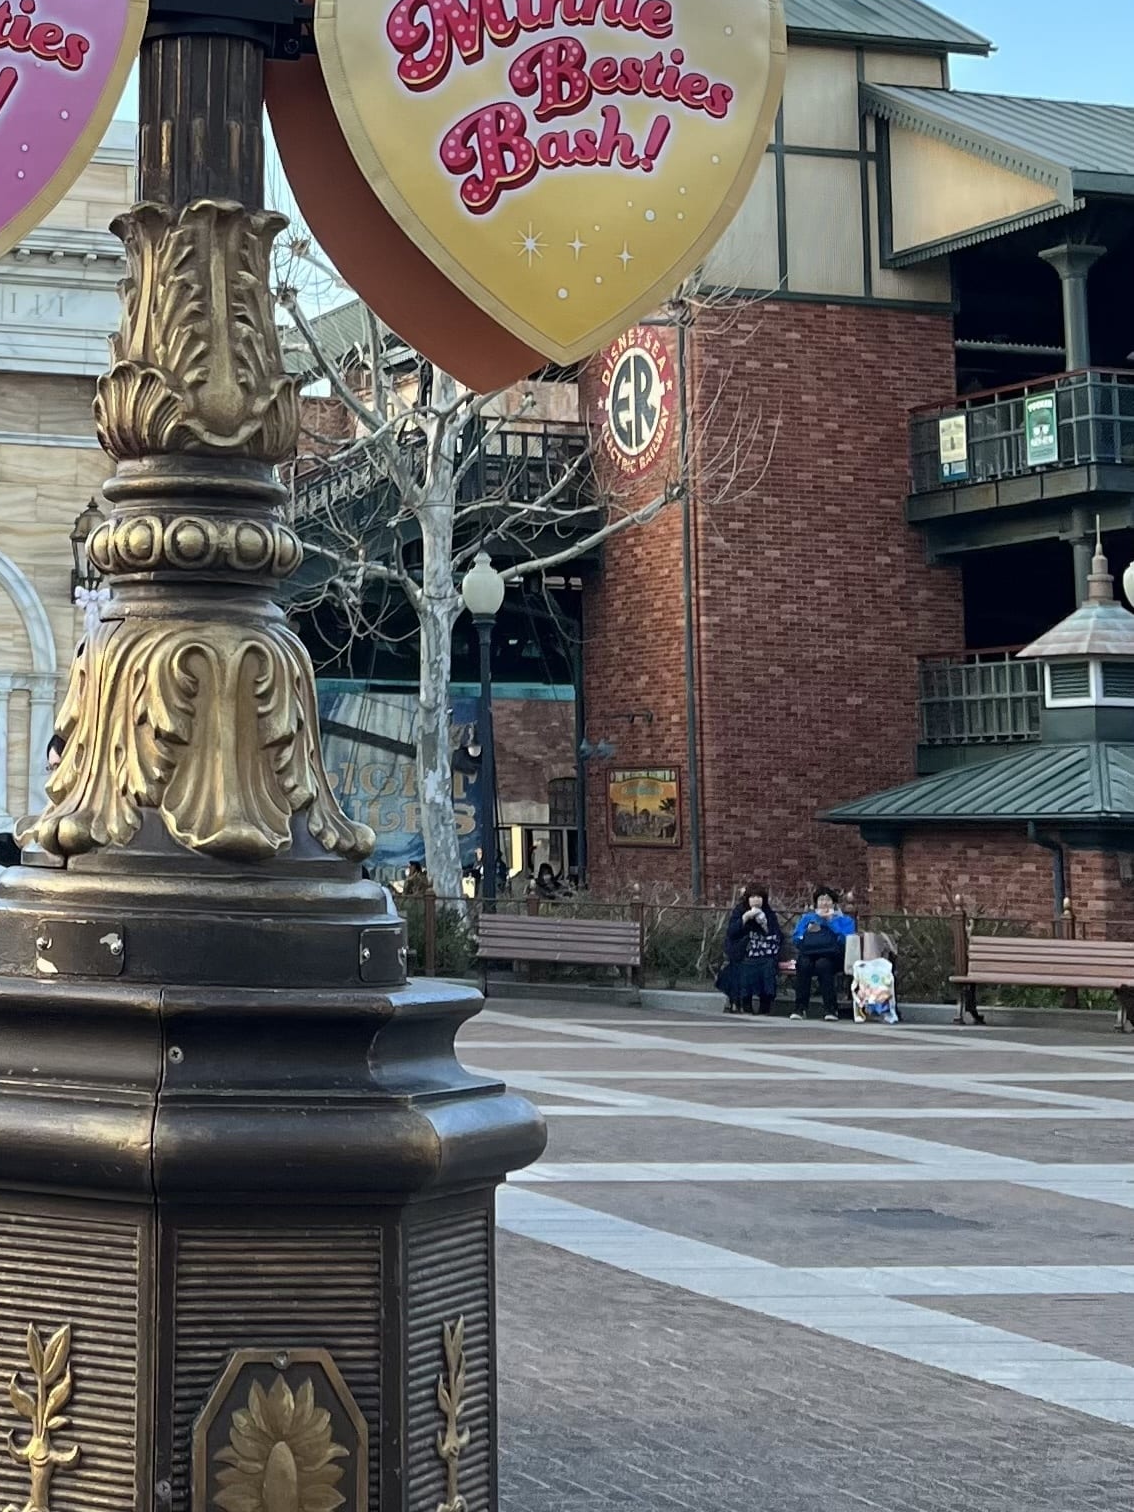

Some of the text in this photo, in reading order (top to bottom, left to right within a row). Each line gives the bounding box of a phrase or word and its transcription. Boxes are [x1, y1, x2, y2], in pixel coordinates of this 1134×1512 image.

[509, 36, 733, 123] Besties
[440, 102, 670, 215] Bash!
[601, 327, 667, 387] DISNEYSEA
